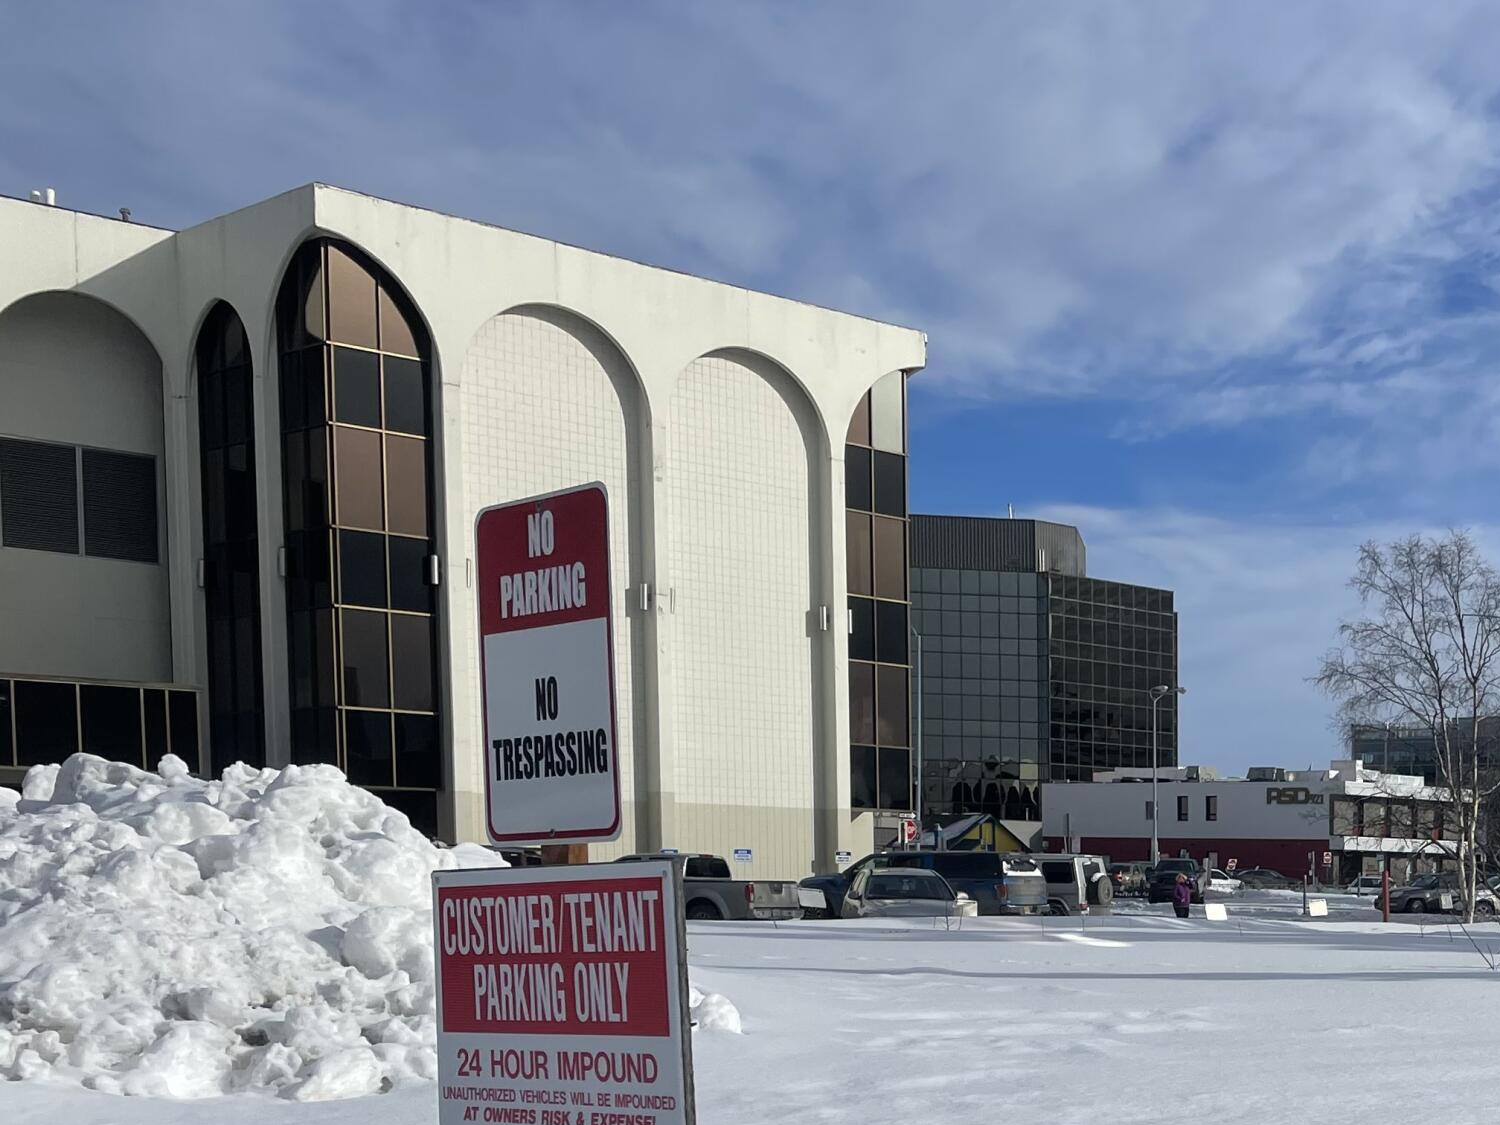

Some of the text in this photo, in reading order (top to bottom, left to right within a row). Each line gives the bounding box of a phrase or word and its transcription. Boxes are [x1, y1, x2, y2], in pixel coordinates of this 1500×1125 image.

[527, 510, 555, 558] NO
[500, 561, 587, 619] PARKING
[535, 676, 559, 721] NO
[492, 728, 608, 781] TRESPASSING
[442, 890, 659, 956] CUSTOMER/TENANT
[473, 961, 629, 1022] PARKING ONLY
[456, 1048, 659, 1084] 24 HOUR IMPOUND
[443, 1086, 677, 1111] UNAUTHORIZED VEHICLES WILL BE IMPOUNDED
[463, 1106, 480, 1121] AT
[484, 1107, 537, 1125] OWNERS
